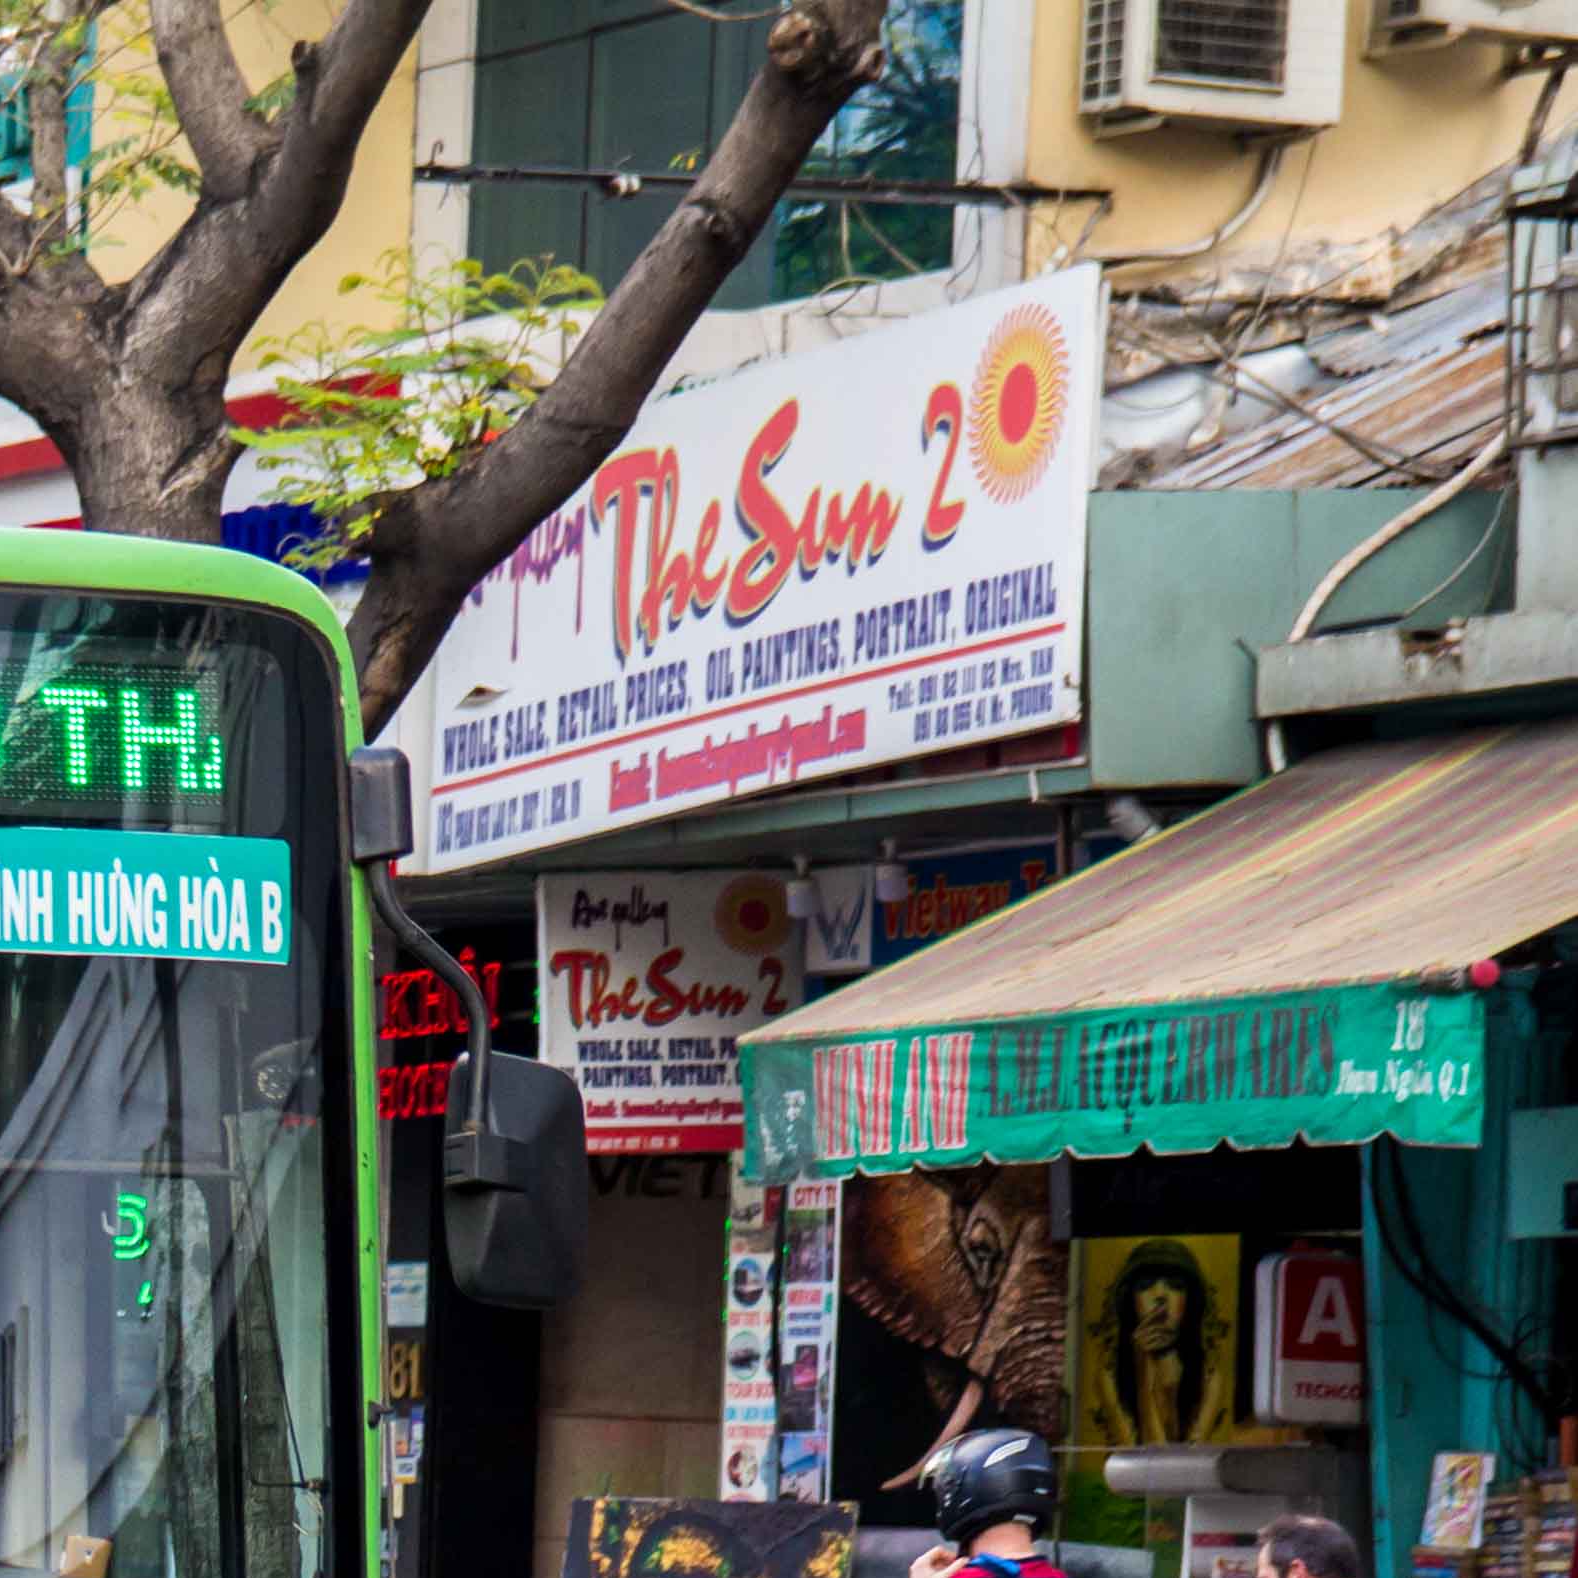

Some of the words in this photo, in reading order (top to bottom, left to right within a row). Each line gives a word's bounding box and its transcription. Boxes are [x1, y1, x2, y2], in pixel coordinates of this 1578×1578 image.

[591, 446, 728, 671] The
[723, 397, 903, 628] Sun
[922, 381, 966, 552] 2
[443, 714, 499, 776] WHOLE
[556, 680, 618, 745] RETAIL
[705, 647, 734, 702] OIL
[965, 561, 1056, 636] ORIGINAL
[40, 685, 223, 792] TH
[67, 857, 169, 949] HƯNG
[178, 856, 252, 952] HÒA
[261, 899, 284, 955] B
[550, 949, 645, 1030] The
[643, 946, 749, 1028] Sun
[758, 956, 788, 1016] 2
[812, 1039, 897, 1161] MINH
[899, 1032, 975, 1153] ANH
